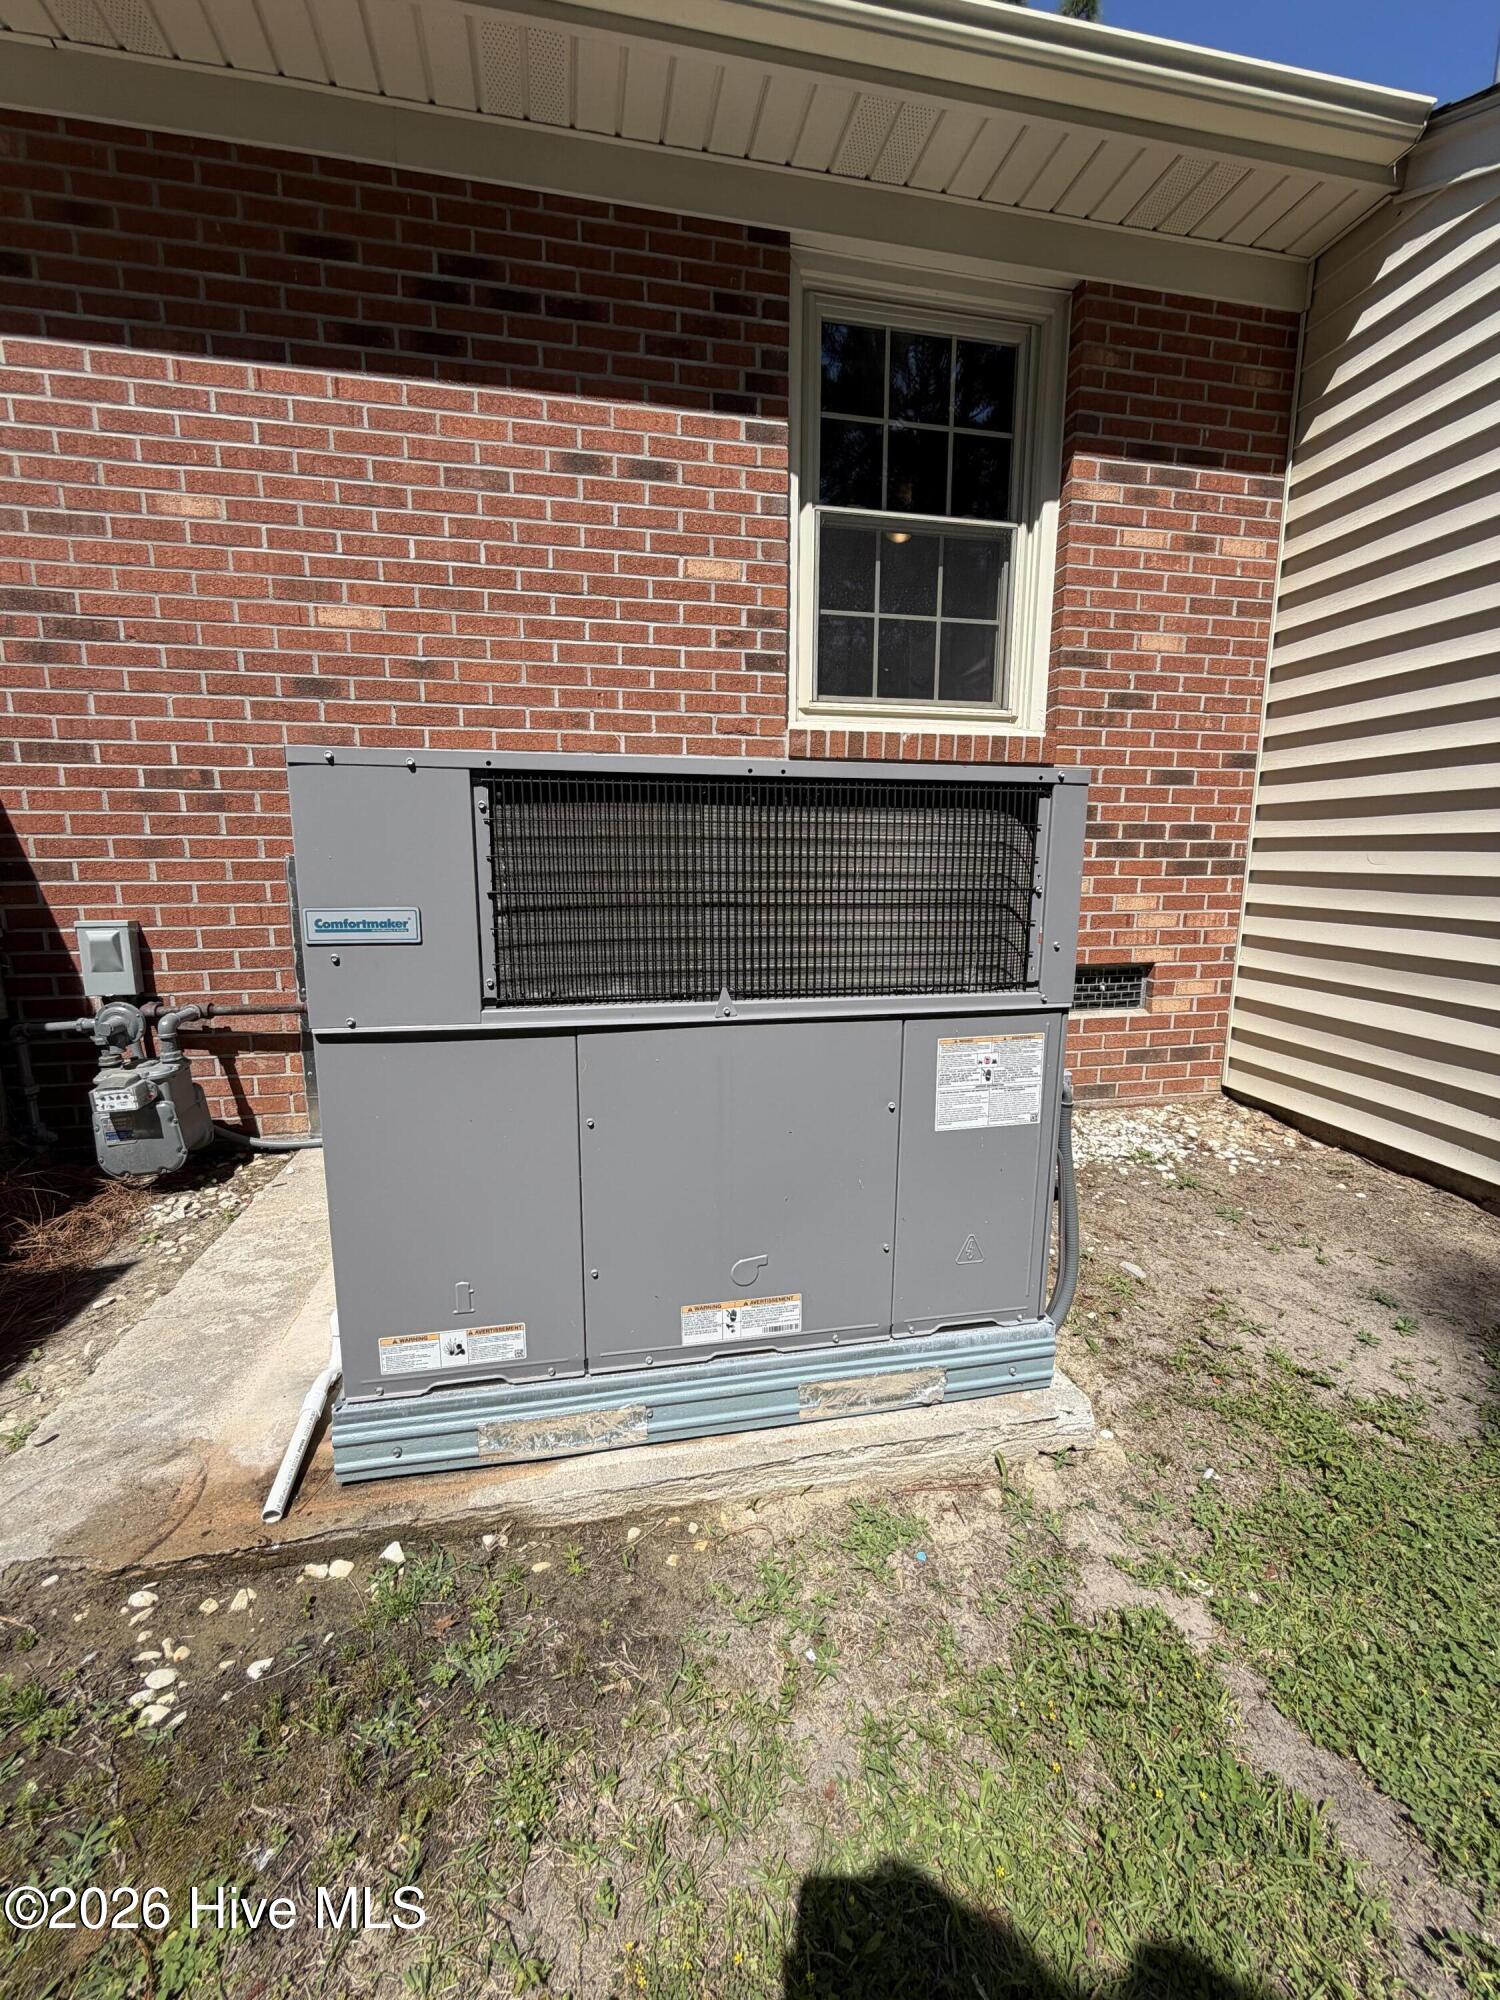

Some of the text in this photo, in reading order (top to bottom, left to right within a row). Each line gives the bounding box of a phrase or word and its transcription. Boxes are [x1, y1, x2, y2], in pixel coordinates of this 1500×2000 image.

[750, 1295, 794, 1305] AVERTISSEMENT
[475, 1325, 522, 1335] AVERTISSEMENT
[399, 1335, 428, 1343] WARNING
